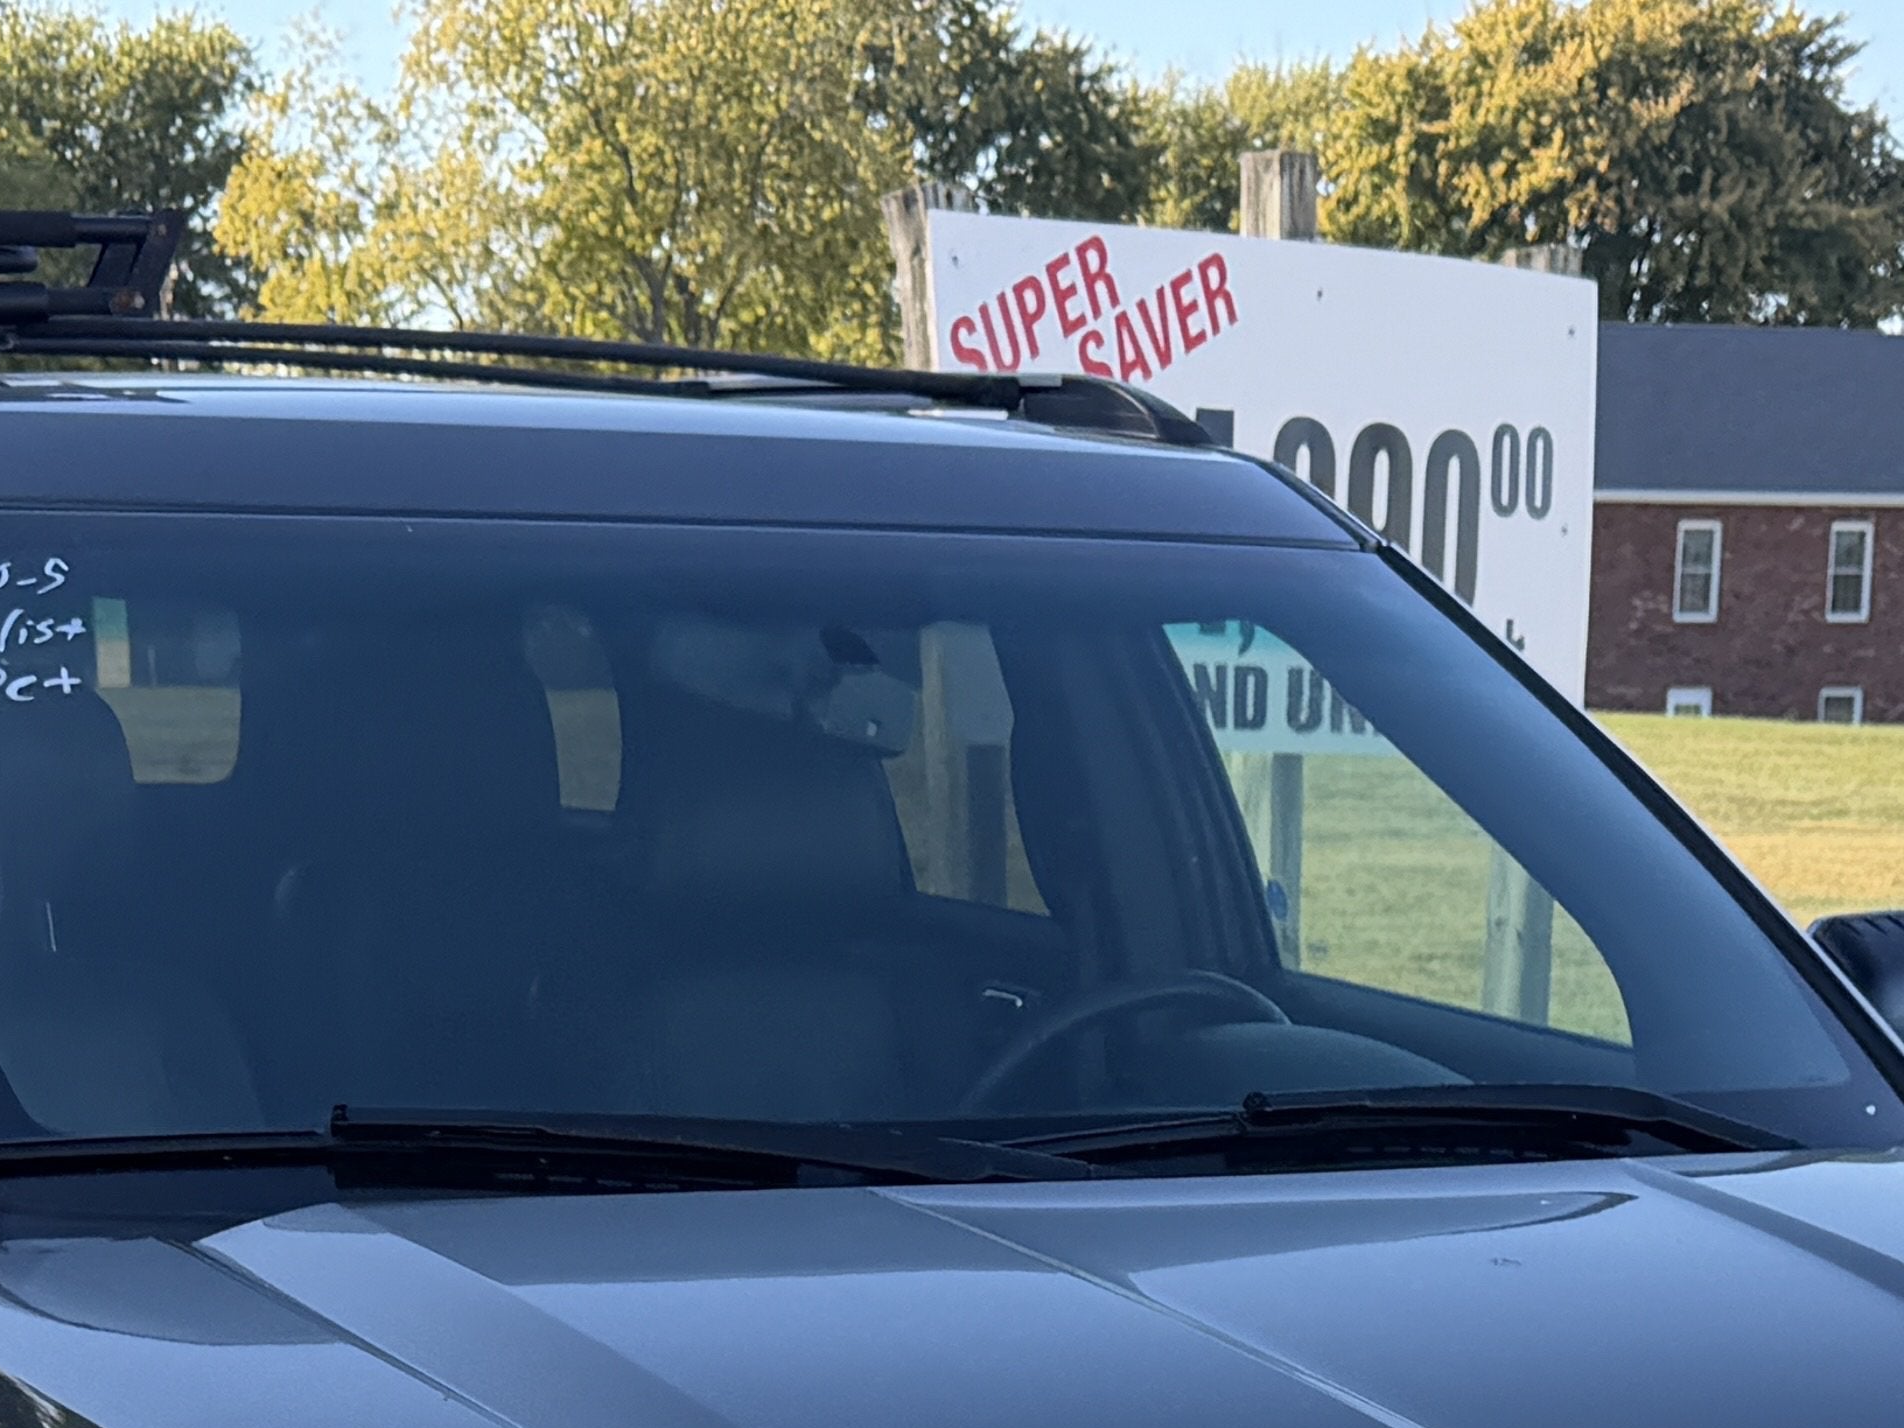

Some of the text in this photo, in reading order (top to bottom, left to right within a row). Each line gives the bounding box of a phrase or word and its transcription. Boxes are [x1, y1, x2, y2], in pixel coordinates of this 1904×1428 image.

[949, 234, 1121, 373] SUPER
[1078, 251, 1239, 384] SAVER
[1192, 662, 1268, 731] ND
